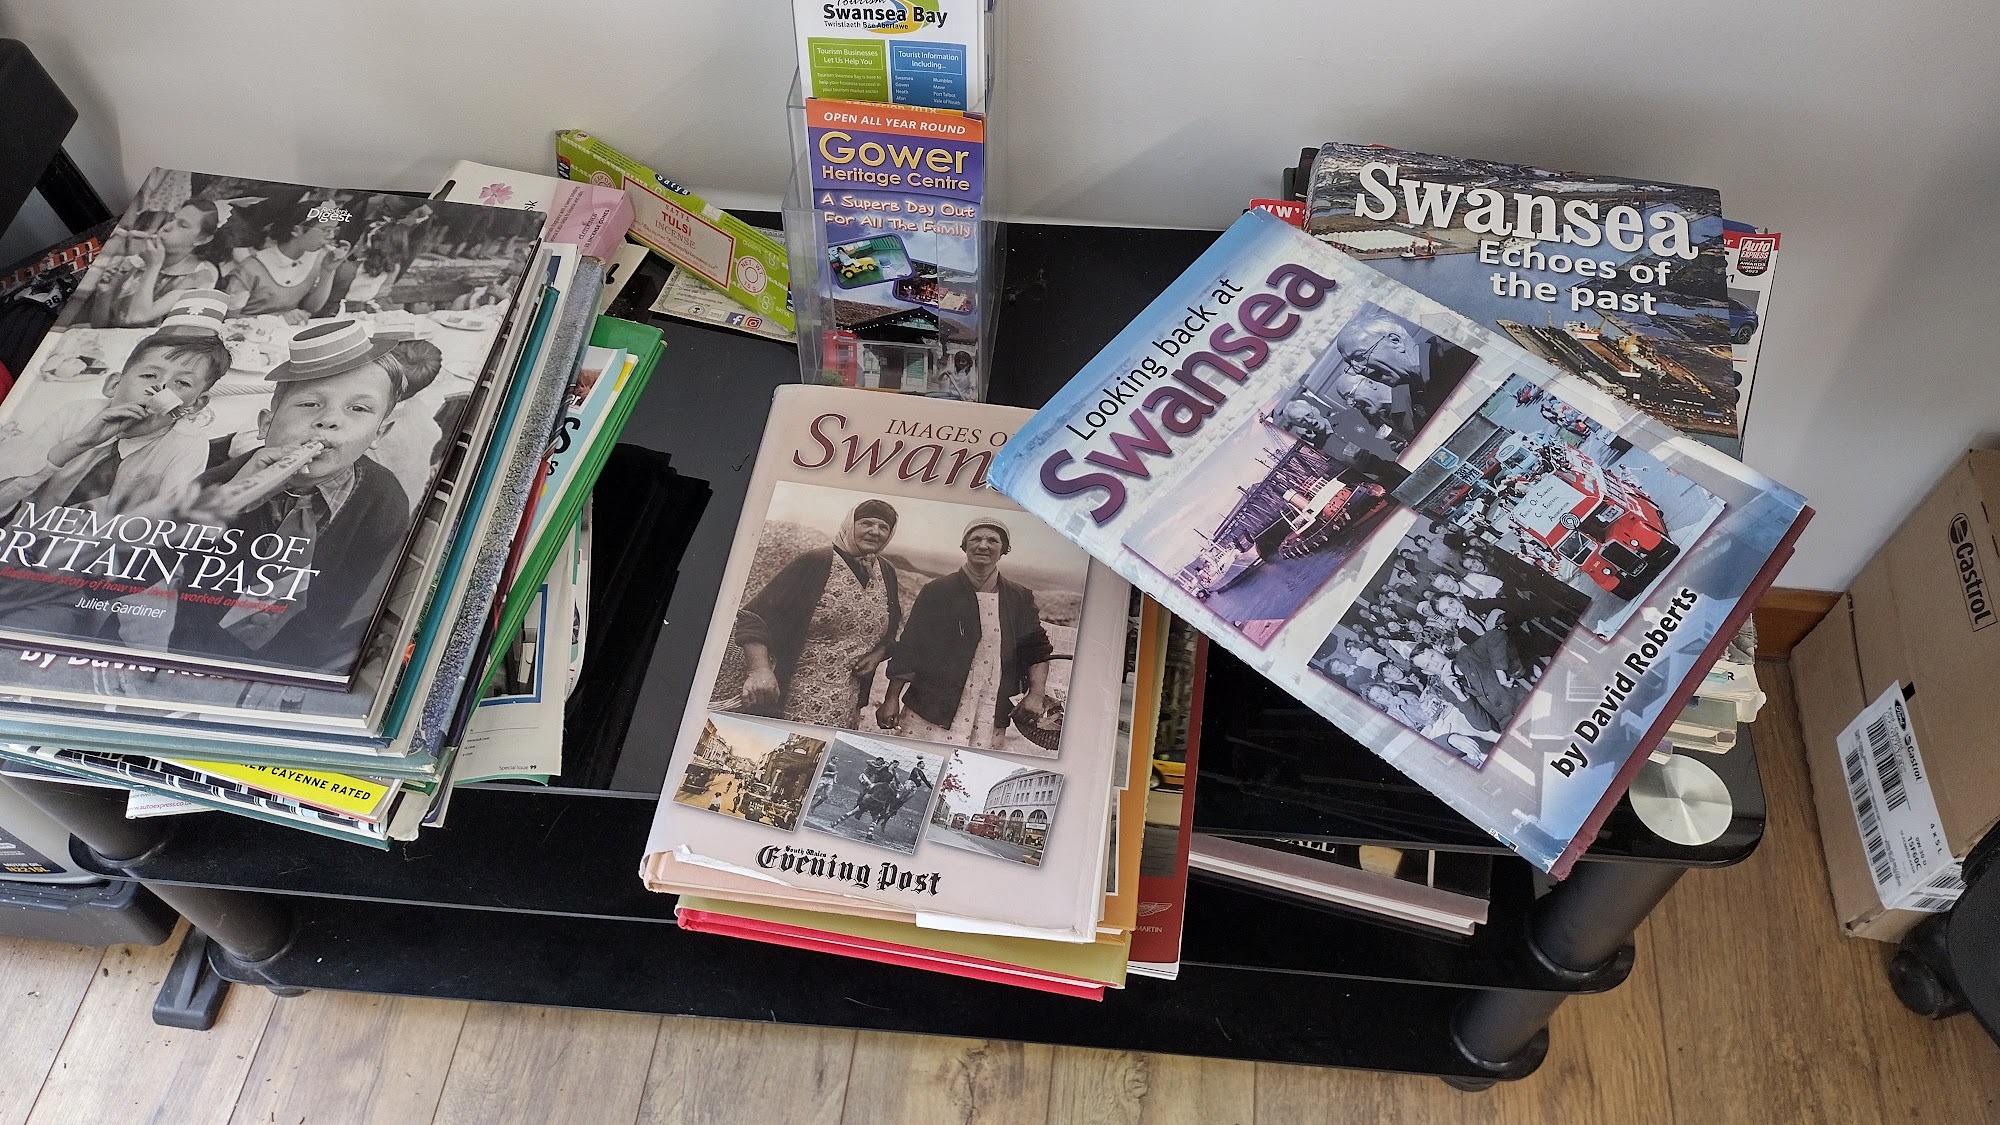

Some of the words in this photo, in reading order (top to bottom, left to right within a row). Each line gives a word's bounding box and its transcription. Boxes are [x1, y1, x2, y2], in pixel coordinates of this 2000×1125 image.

[823, 3, 907, 22] Swansea
[913, 6, 948, 28] Bay
[843, 49, 878, 57] Businesses
[844, 58, 860, 66] Help
[898, 50, 921, 59] Tourist
[921, 51, 959, 61] Information
[823, 111, 857, 123] OPEN
[860, 114, 882, 126] ALL
[884, 117, 917, 130] YEAR
[920, 121, 966, 135] ROUND
[819, 130, 969, 174] Gower
[656, 173, 691, 196] Satya
[821, 165, 902, 188] Heritage
[906, 171, 970, 191] Centre
[306, 208, 353, 223] Digest
[665, 204, 690, 223] SATYA
[821, 193, 836, 206] A
[905, 200, 935, 217] Day
[940, 203, 976, 218] Out
[1353, 160, 1701, 261] Swansea
[587, 222, 602, 243] INCENSE
[598, 209, 610, 226] CONES
[654, 219, 696, 250] INCENSE
[661, 211, 692, 237] TULSI
[823, 211, 856, 224] For
[860, 214, 883, 229] All
[888, 217, 918, 232] The
[1740, 251, 1769, 259] EXPRESS
[1742, 240, 1771, 252] Auto
[1479, 238, 1619, 281] Echoes
[1629, 257, 1673, 288] of
[1491, 269, 1558, 303] the
[1571, 278, 1659, 318] past
[1065, 356, 1169, 442] Looking
[1152, 304, 1218, 358] back
[1211, 277, 1245, 307] at
[1039, 263, 1337, 524] Swansea
[884, 418, 982, 445] IMAGES
[12, 501, 244, 557] MEMORIES
[250, 532, 311, 564] OF
[58, 576, 88, 588] story
[88, 578, 103, 591] of
[102, 580, 127, 592] how
[180, 591, 224, 605] worked
[188, 554, 321, 602] PAST
[1956, 541, 1992, 625] Castrol
[75, 597, 110, 611] Juliet
[111, 601, 167, 619] Gardiner
[1549, 742, 1590, 778] by
[1574, 671, 1637, 745] David
[1624, 587, 1698, 676] Roberts
[1907, 745, 1923, 781] Castrol
[270, 767, 330, 790] CAYENNE
[330, 783, 372, 801] RATED
[785, 845, 805, 855] South
[805, 848, 827, 858] Wales
[1907, 836, 1922, 870] 15F60C
[1937, 847, 1943, 855] L
[753, 844, 871, 890] Evening
[875, 861, 942, 897] Post
